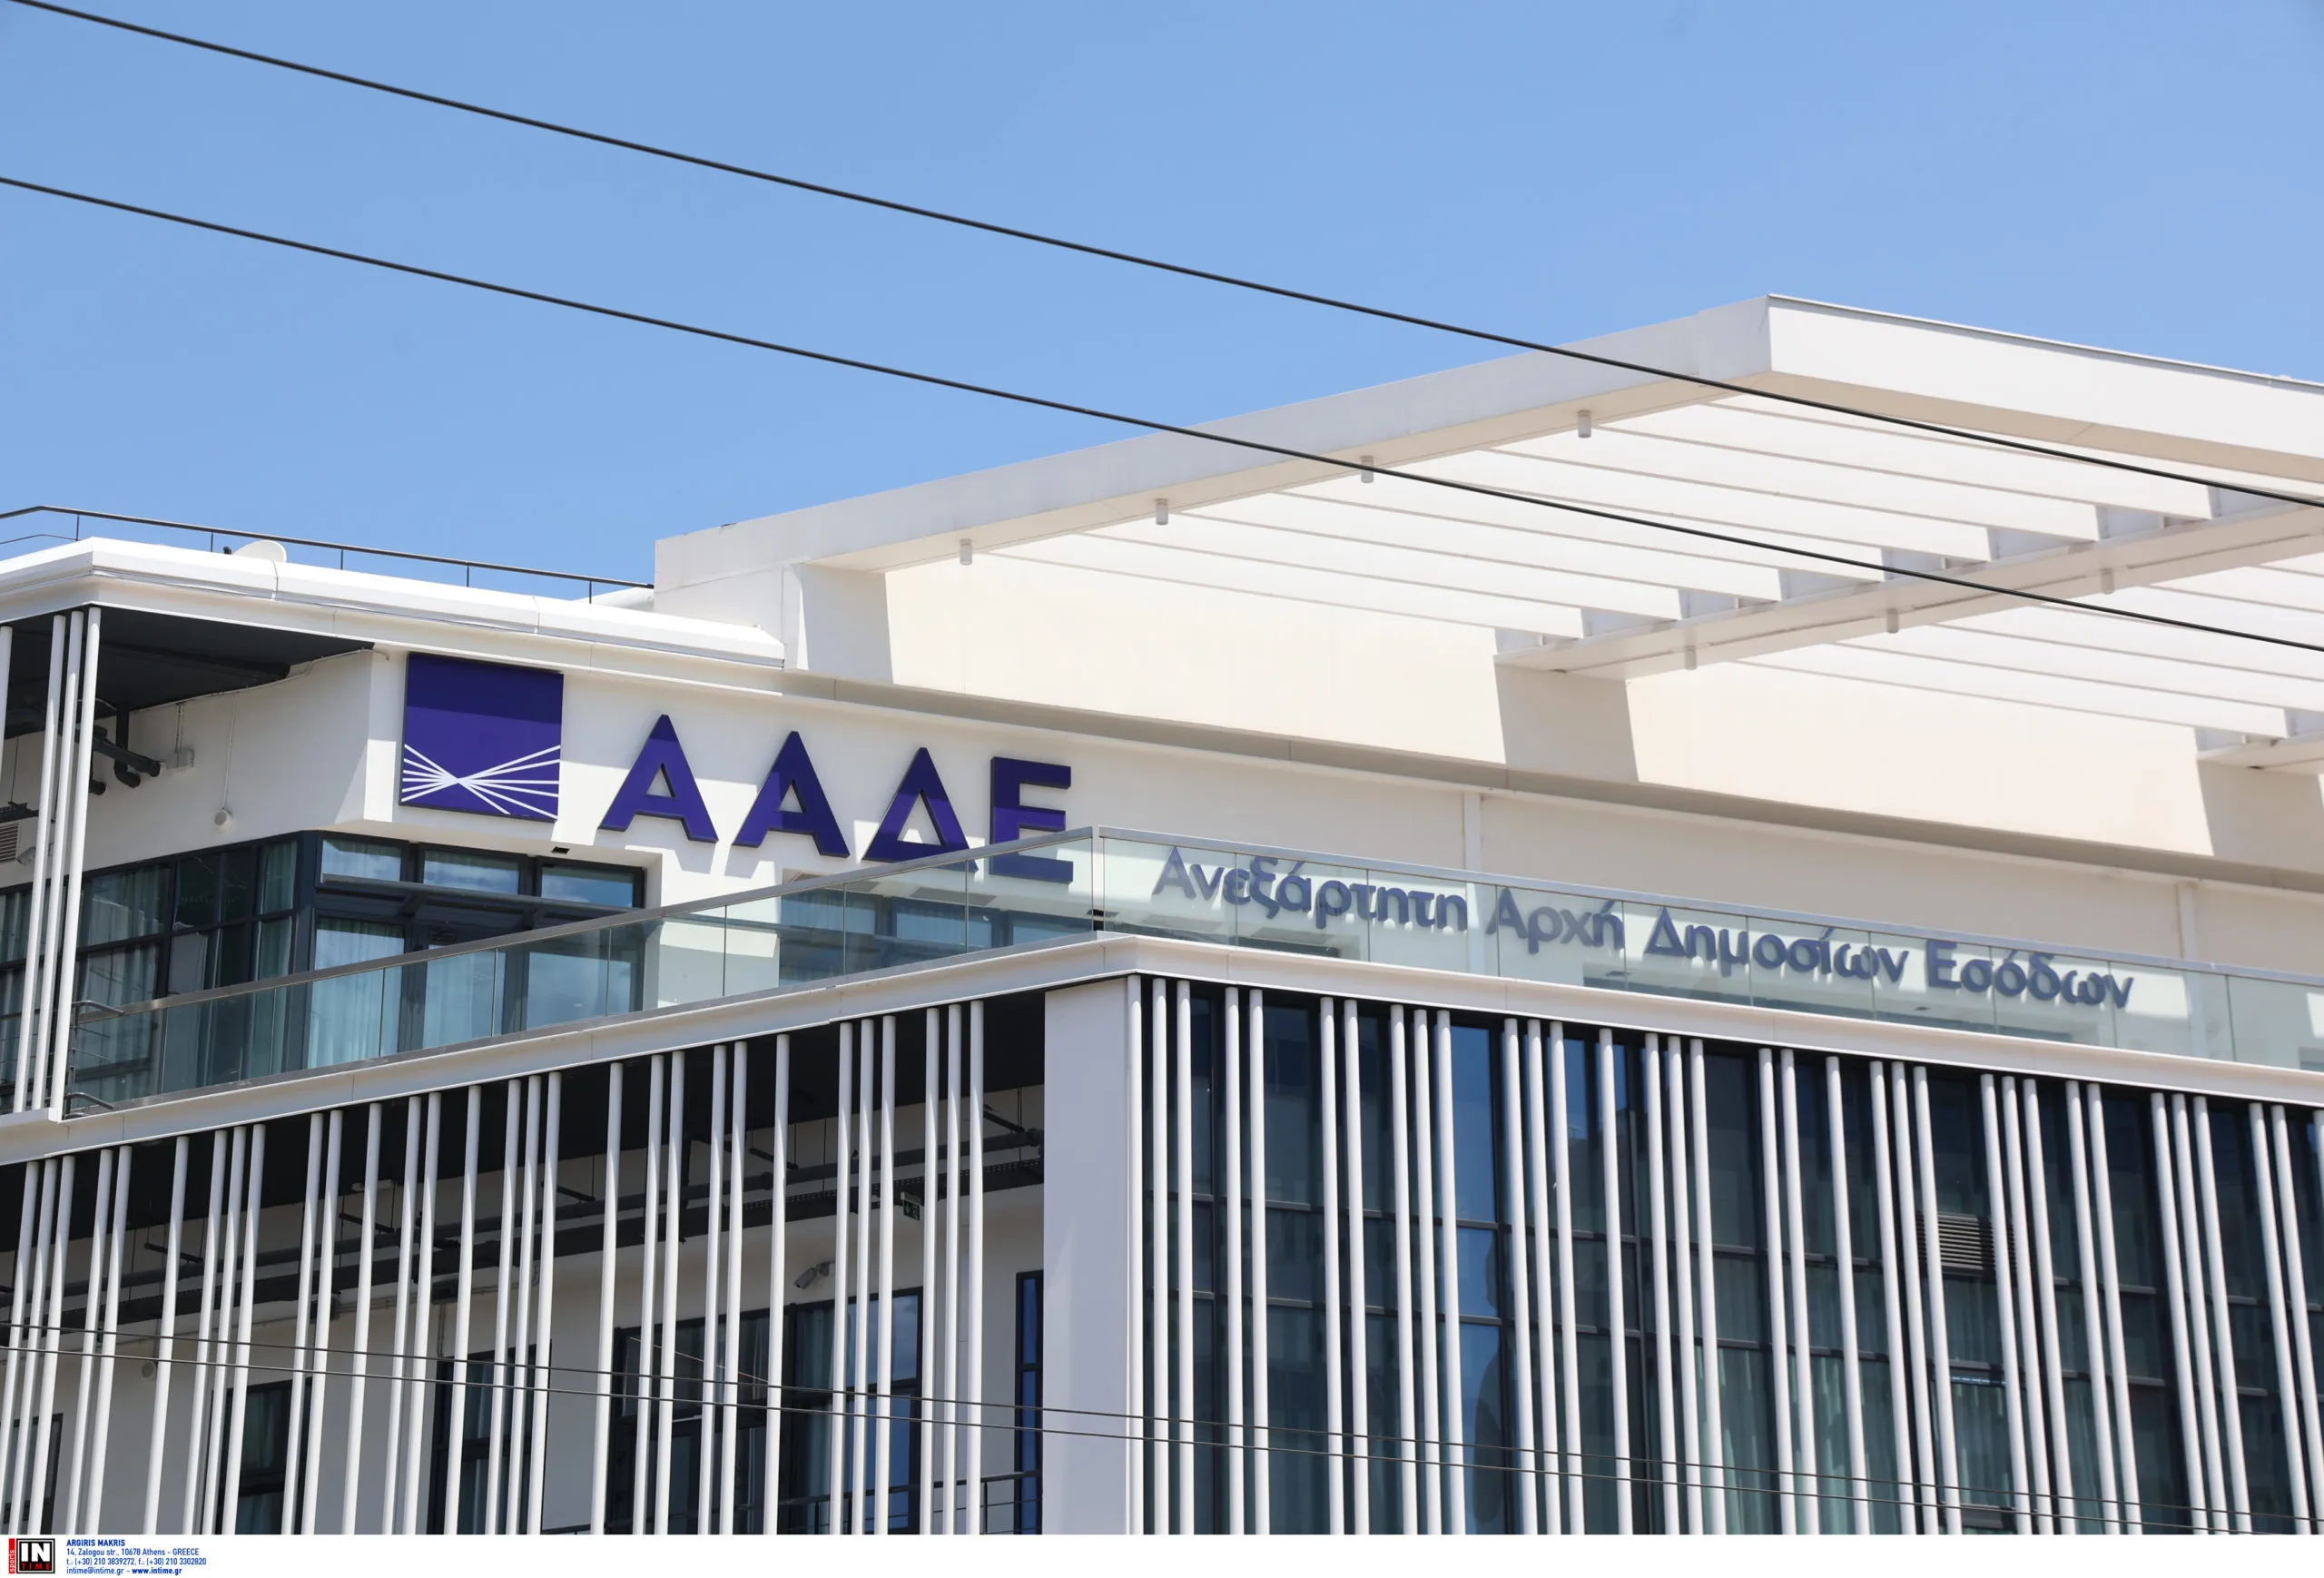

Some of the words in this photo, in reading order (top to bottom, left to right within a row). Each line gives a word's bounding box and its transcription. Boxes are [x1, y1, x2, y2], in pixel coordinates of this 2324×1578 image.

[598, 714, 1072, 884] ΑΑΔΕ
[1152, 846, 1468, 932] Ανεξάρτητη
[1487, 887, 1625, 954] Αρχή
[1644, 906, 1909, 983] Δημοσίων
[1925, 940, 2134, 1009] Εσόδων
